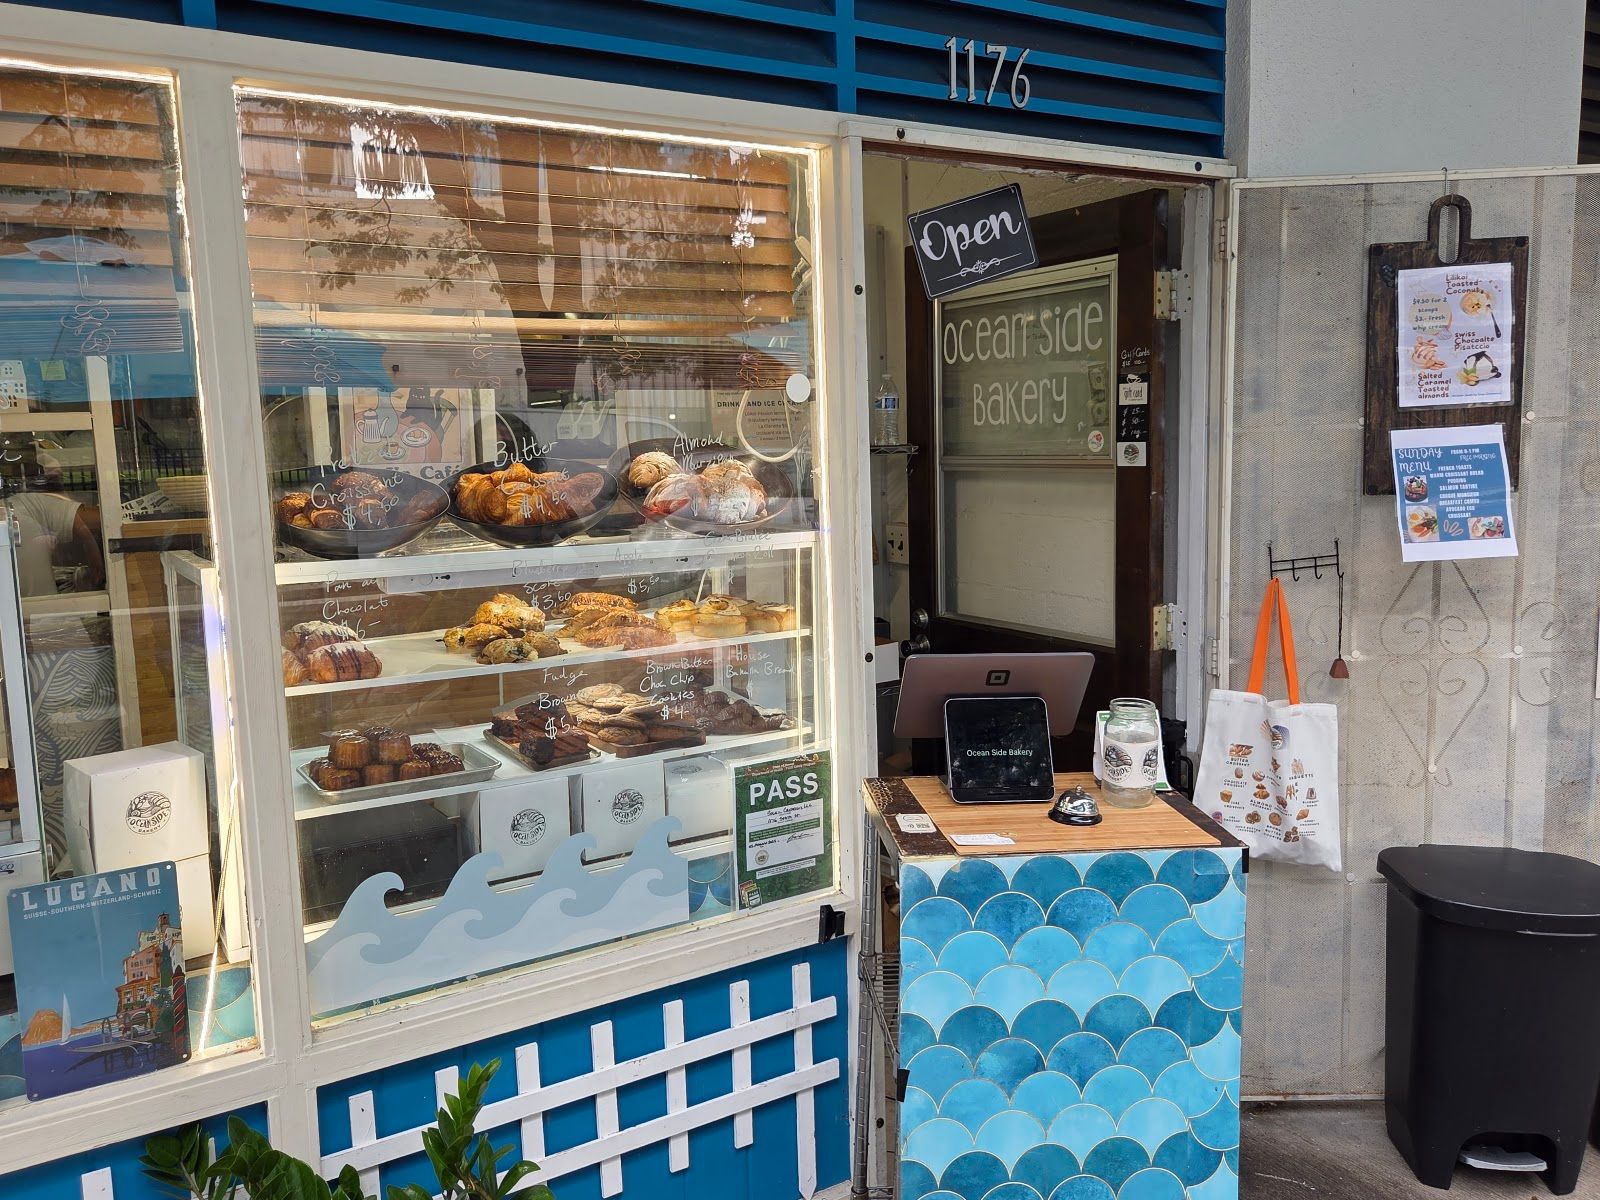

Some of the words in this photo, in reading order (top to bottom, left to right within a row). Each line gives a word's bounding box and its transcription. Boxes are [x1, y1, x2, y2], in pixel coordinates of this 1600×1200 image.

[945, 36, 1031, 109] 1176
[919, 210, 1022, 266] Open
[1417, 378, 1452, 387] Caramel
[1418, 371, 1443, 380] Salted
[1417, 385, 1450, 393] Toasted
[717, 400, 741, 408] DRINK
[747, 399, 762, 407] AND
[764, 399, 776, 407] ICE
[494, 436, 559, 468] Butter
[673, 431, 724, 457] Almond
[1398, 447, 1443, 459] SUNDAY
[1399, 460, 1432, 474] MENU
[311, 472, 404, 509] Croissnt
[322, 595, 389, 620] Chocolat
[542, 666, 589, 687] Fudge
[966, 749, 990, 757] Ocean
[991, 748, 1008, 756] Side
[1008, 748, 1033, 758] Bakery
[749, 772, 819, 806] PASS
[21, 867, 161, 911] LUGANO
